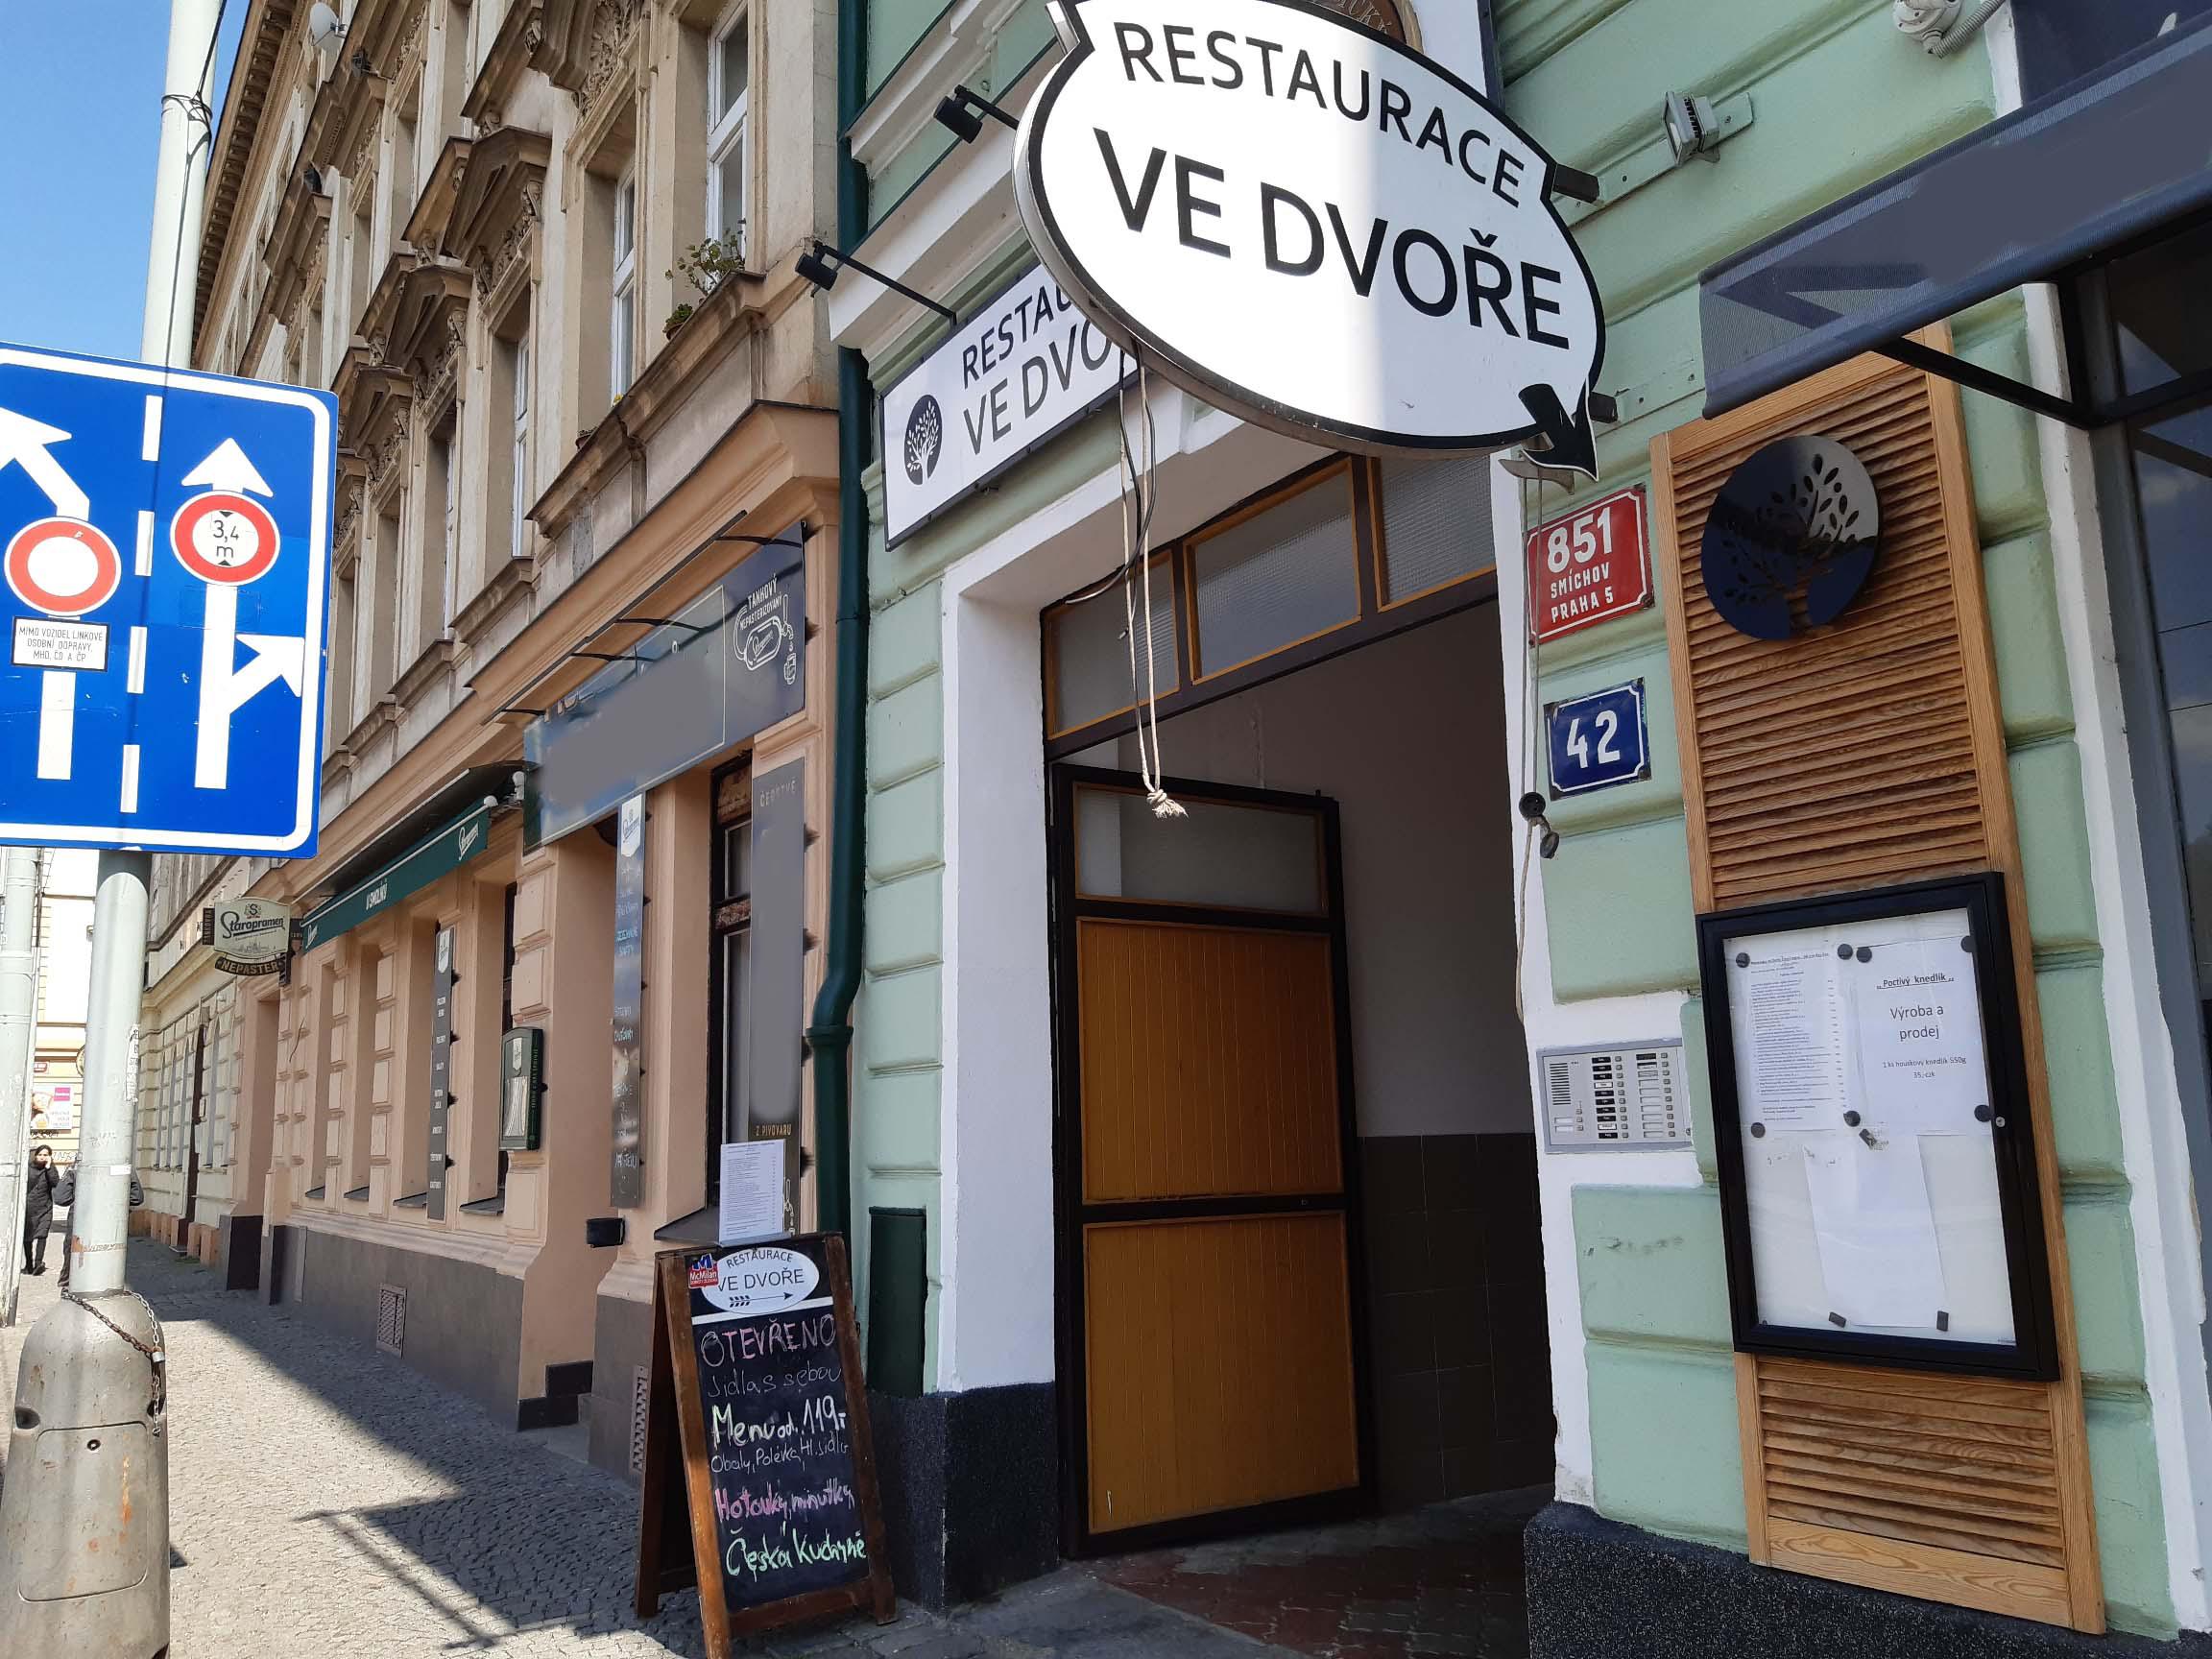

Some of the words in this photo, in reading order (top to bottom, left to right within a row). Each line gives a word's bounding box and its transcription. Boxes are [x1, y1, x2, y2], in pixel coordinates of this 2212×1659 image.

[1113, 21, 1526, 209] RESTAURACE
[1093, 127, 1231, 259] VE
[1260, 180, 1570, 350] DVOŘE
[963, 377, 1012, 456] VE
[212, 519, 239, 543] 3,4
[1547, 506, 1613, 573] 851
[216, 545, 234, 558] m
[747, 573, 778, 610] TANKOVÝ
[1551, 562, 1610, 599] SMÍCHOV
[1551, 591, 1599, 623] PRAHA
[1604, 586, 1614, 604] 5
[18, 626, 39, 637] MIMO
[41, 628, 70, 639] VOZIDEL
[72, 629, 103, 641] LINKOVÉ
[27, 637, 55, 649] OSOBNÍ
[67, 653, 73, 661] A
[76, 651, 86, 662] ČP
[1566, 709, 1622, 770] 42
[759, 777, 797, 807] ČETVÉ
[220, 910, 285, 939] Staropramen
[221, 959, 279, 975] NEPASTER
[1889, 1004, 1934, 1022] Výroba
[1936, 1005, 1944, 1016] a
[1899, 1024, 1939, 1042] prodej
[756, 1125, 760, 1137] Z
[761, 1123, 792, 1137] PIVOVARU
[726, 1249, 793, 1269] RESTAURACE
[718, 1275, 738, 1292] VE
[744, 1267, 805, 1289] DVOŘE
[700, 1313, 837, 1367] OTEVŘENO
